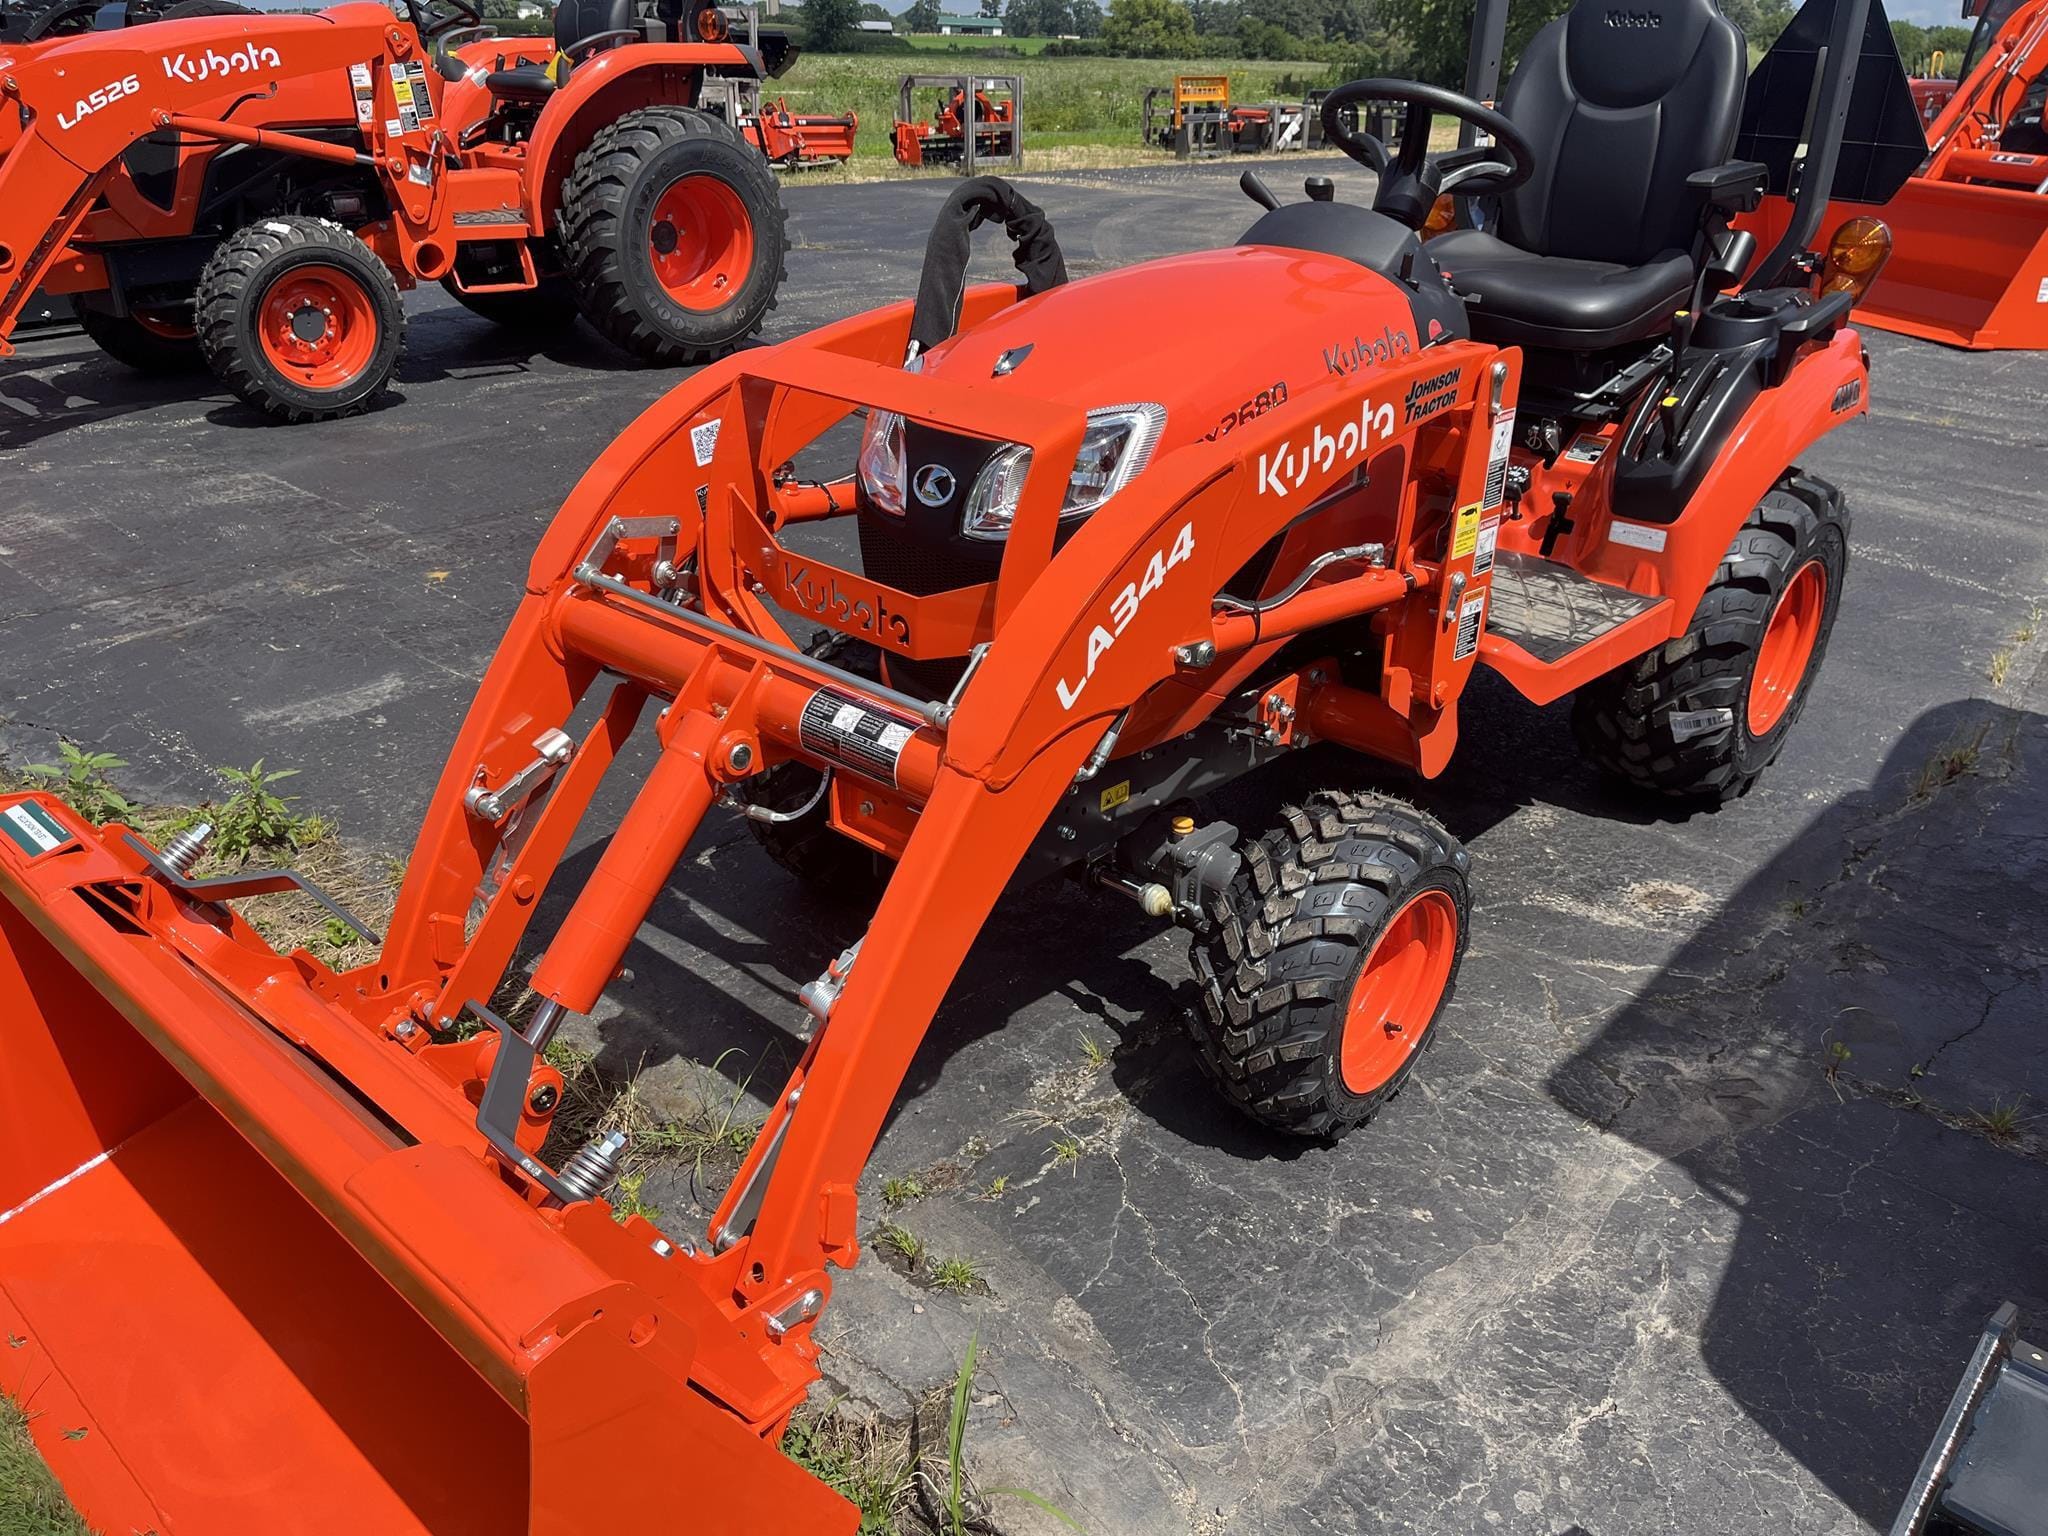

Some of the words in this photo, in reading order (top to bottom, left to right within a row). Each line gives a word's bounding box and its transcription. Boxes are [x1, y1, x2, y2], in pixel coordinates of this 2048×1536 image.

[1603, 10, 1661, 28] Kubota
[162, 42, 281, 83] Kubota
[57, 74, 140, 130] LA526
[1322, 326, 1411, 377] Kubota
[1404, 367, 1461, 404] JOHNSON
[1404, 389, 1458, 425] TRACTOR
[1258, 398, 1395, 497] Kubota
[785, 561, 910, 648] Kubota
[1056, 521, 1195, 710] LA344
